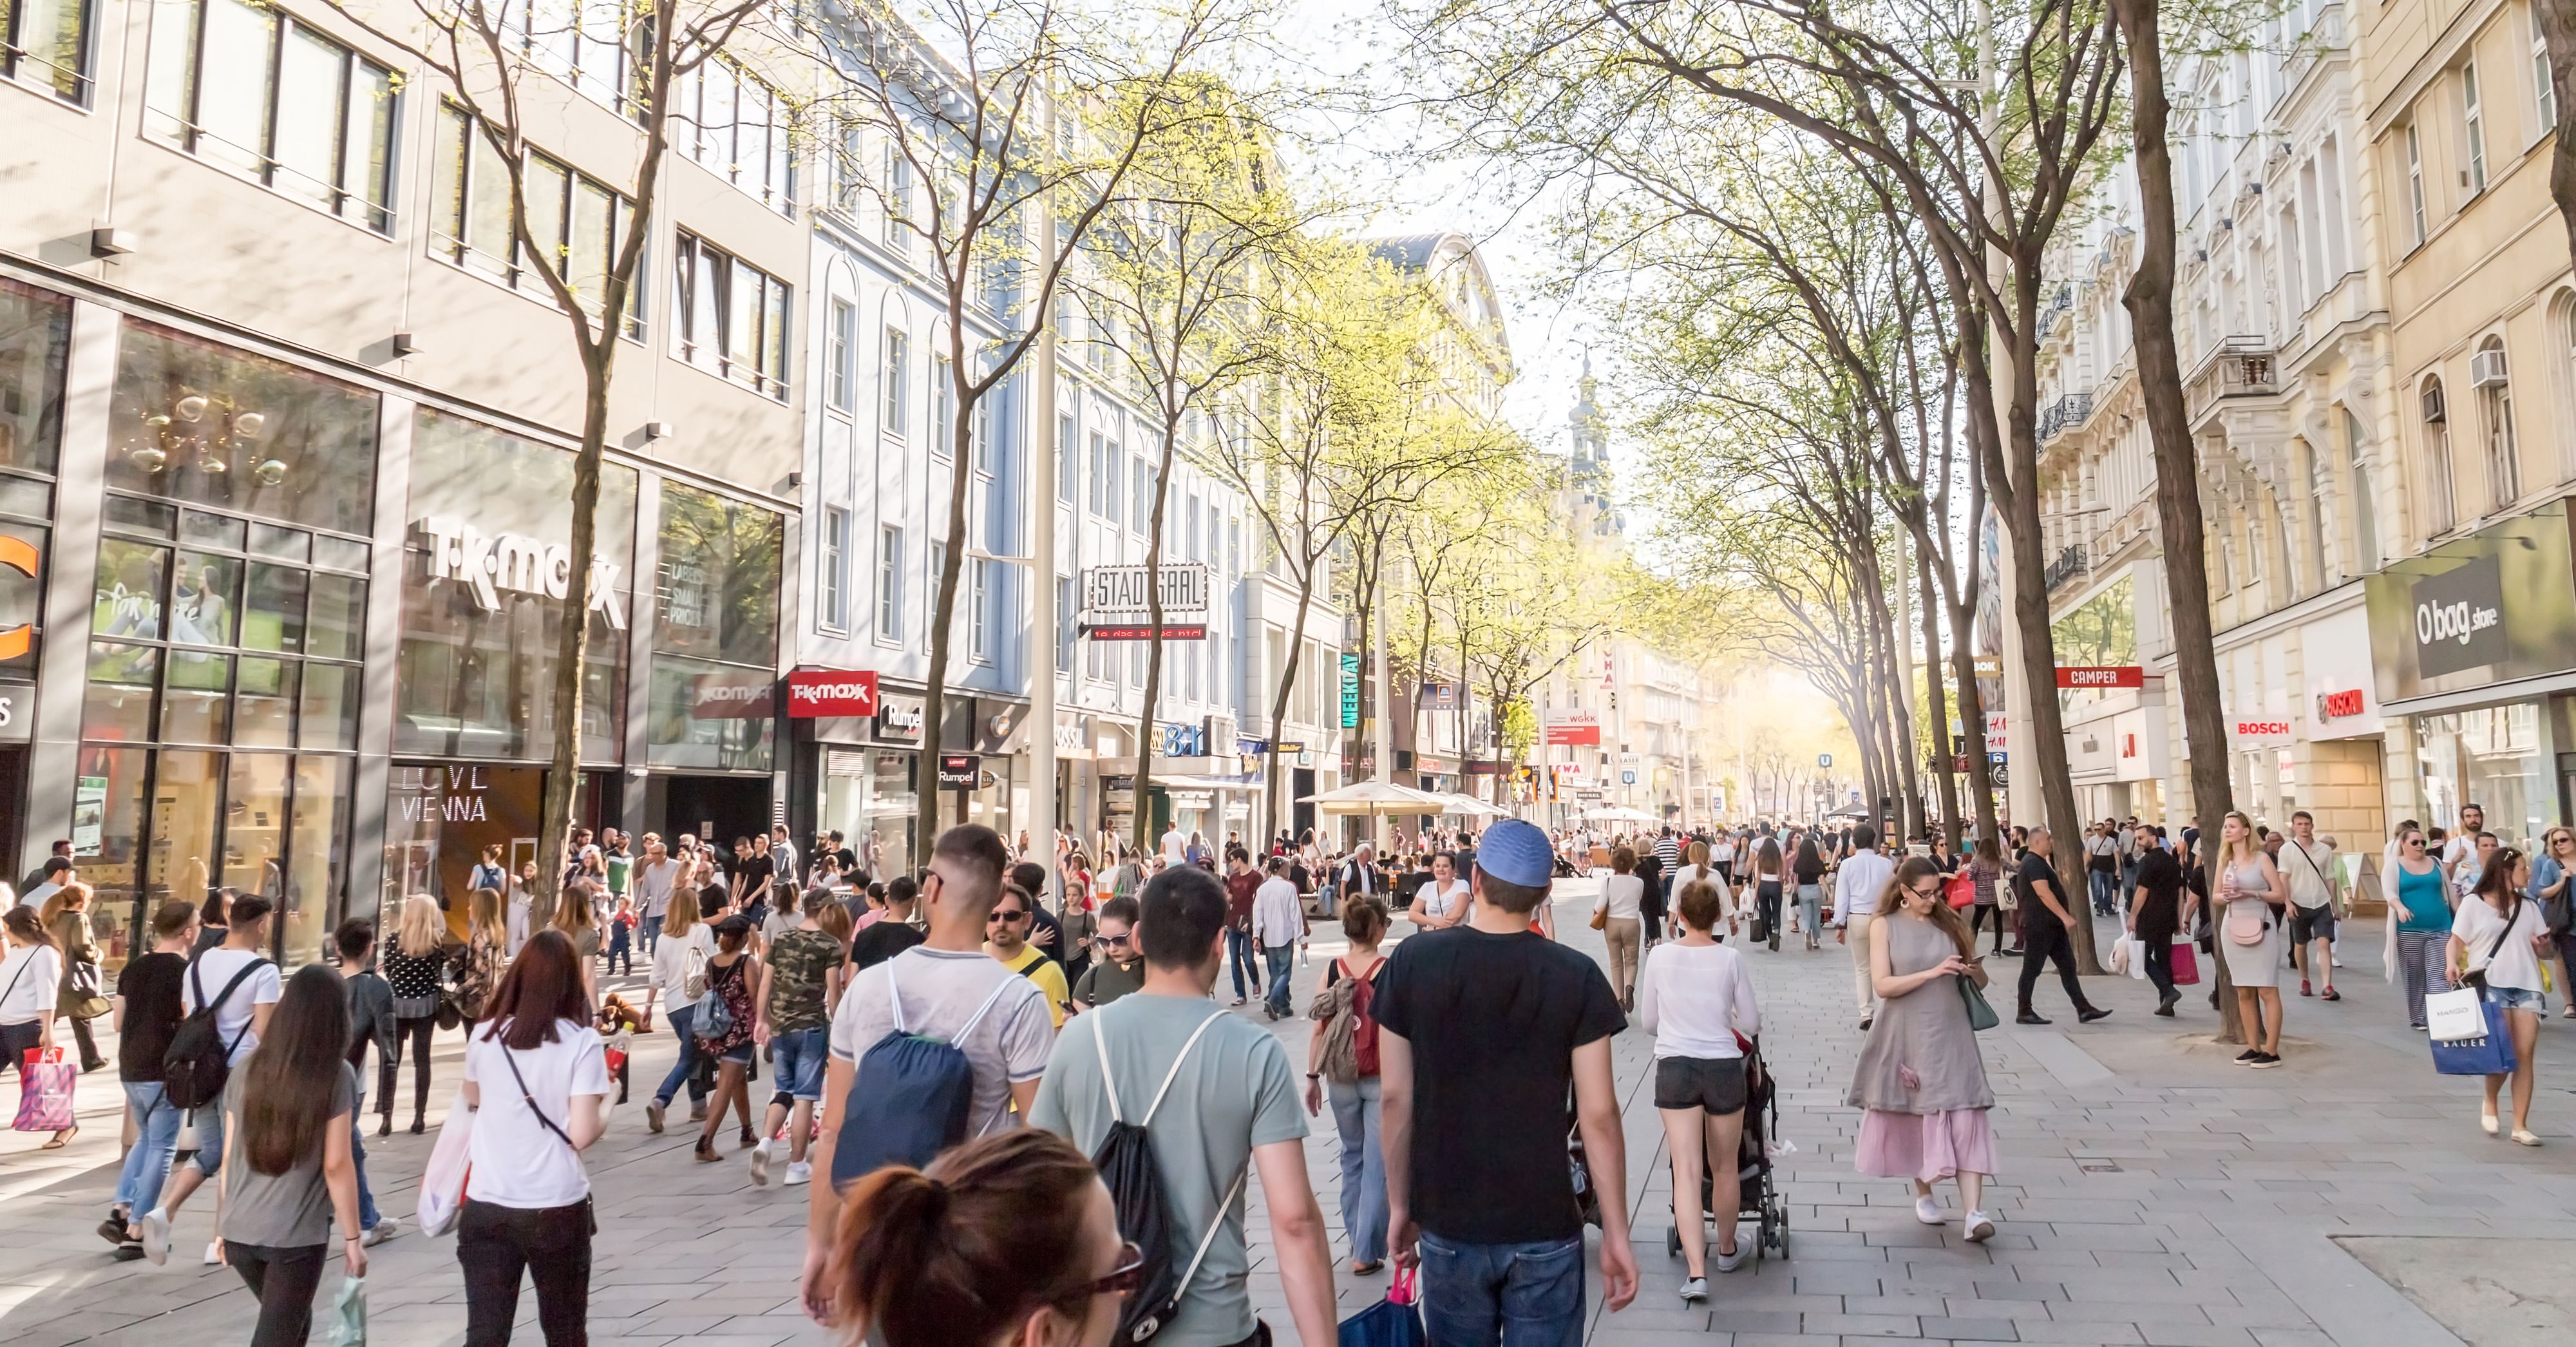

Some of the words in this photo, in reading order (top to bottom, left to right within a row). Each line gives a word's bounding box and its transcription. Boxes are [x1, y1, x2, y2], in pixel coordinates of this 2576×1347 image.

[672, 587, 701, 607] SMALL
[1099, 570, 1200, 606] STADSAAL
[670, 606, 701, 627] PRICES
[2418, 604, 2432, 644] O
[2432, 599, 2470, 645] bag
[2070, 671, 2117, 684] CAMPER
[1342, 654, 1358, 727] WEEKDAY
[2327, 689, 2363, 717] BOSCH
[889, 704, 922, 730] Rumpel
[1056, 725, 1084, 749] OSSIL
[2239, 723, 2289, 734] BOSCH
[1164, 724, 1196, 756] 81
[1821, 756, 1830, 766] U
[939, 771, 974, 783] Rumpel
[401, 796, 486, 821] VIENNA
[2436, 1007, 2468, 1017] MANGO
[2443, 1038, 2486, 1048] BAUER
